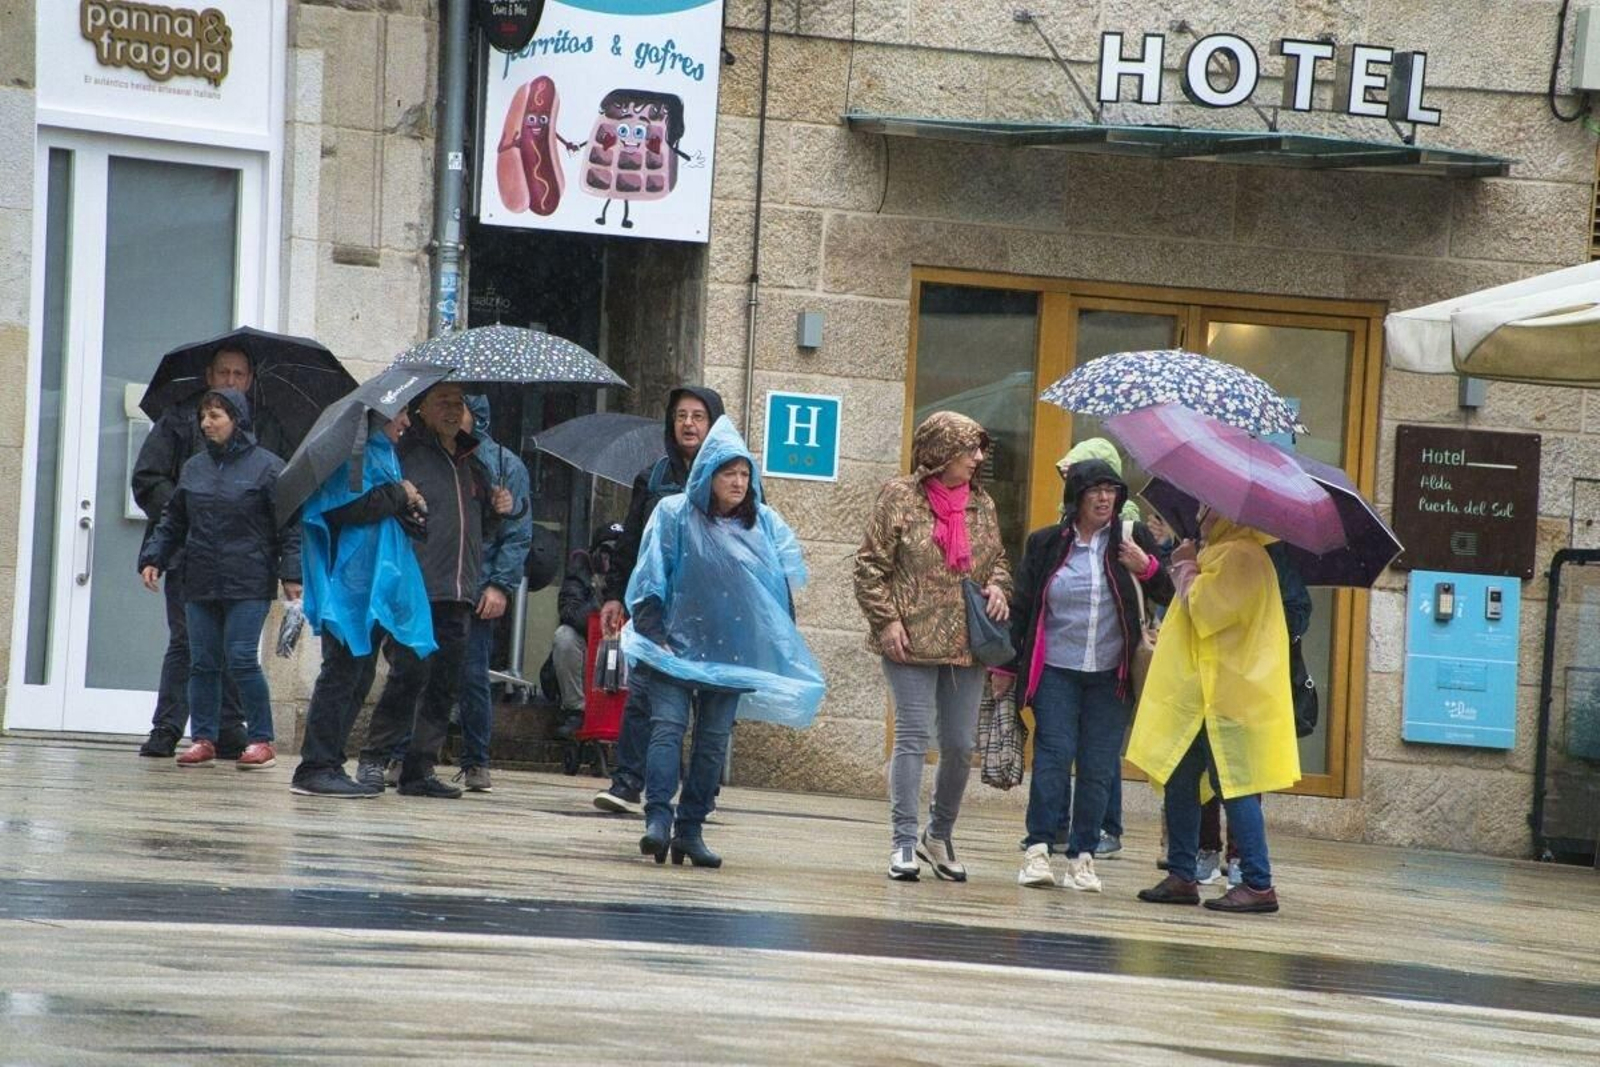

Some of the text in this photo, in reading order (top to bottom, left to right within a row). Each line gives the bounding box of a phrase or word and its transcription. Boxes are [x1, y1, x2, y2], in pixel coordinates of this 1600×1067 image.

[87, 4, 229, 48] panna &
[100, 29, 222, 75] fragola
[610, 34, 622, 56] &
[634, 38, 705, 82] gofres
[84, 74, 92, 84] El
[1097, 31, 1442, 126] HOTEL
[783, 404, 823, 448] H
[1421, 448, 1466, 466] Hotel
[1420, 474, 1453, 490] Alda
[1418, 496, 1515, 519] Puerta del Sol
